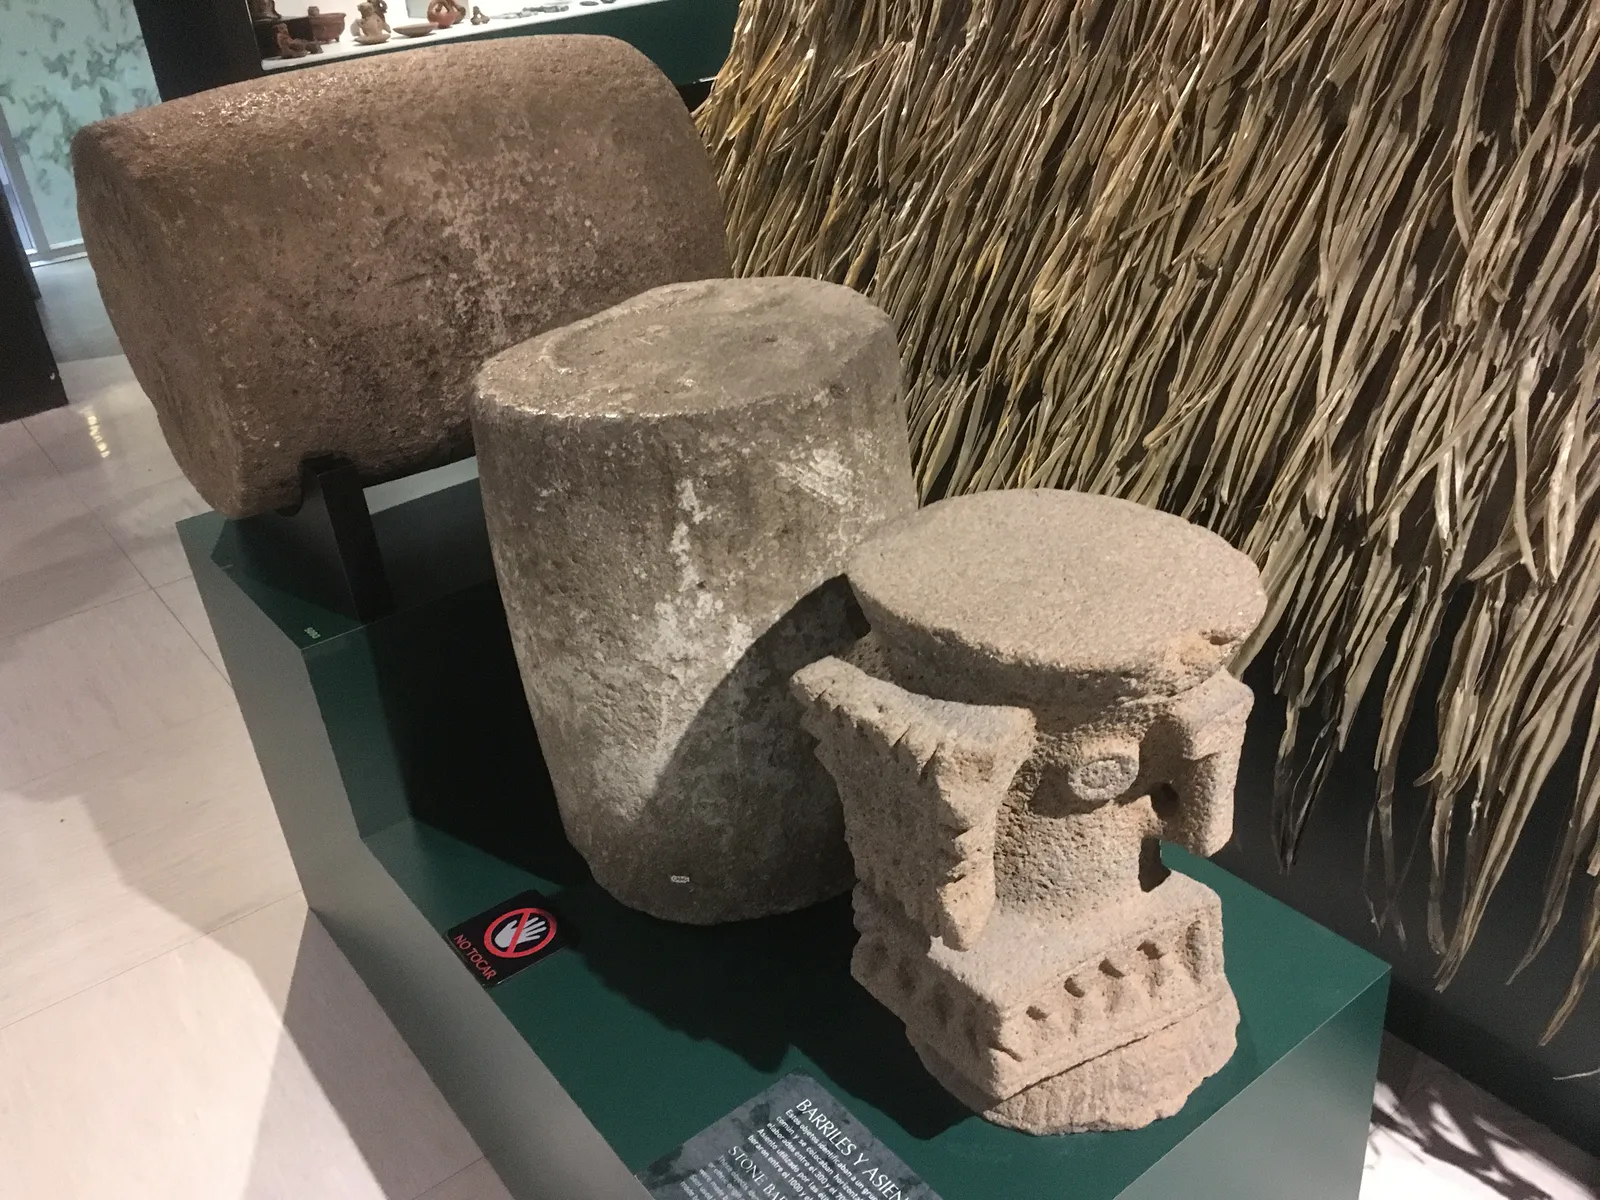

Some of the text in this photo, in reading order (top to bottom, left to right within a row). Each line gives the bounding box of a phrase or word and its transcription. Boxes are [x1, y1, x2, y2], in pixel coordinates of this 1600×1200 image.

[453, 934, 497, 980] NO TOCAR
[748, 1134, 770, 1158] boraron
[767, 1157, 783, 1172] entre
[788, 1177, 803, 1192] 1000
[757, 1128, 778, 1150] Asiento
[776, 1149, 800, 1173] utilizado
[796, 1172, 810, 1182] por
[808, 1181, 819, 1193] las
[767, 1123, 797, 1153] elaborados
[794, 1151, 810, 1167] entre
[814, 1171, 828, 1184] 300
[829, 1187, 838, 1195] el
[776, 1116, 795, 1135] común
[798, 1139, 807, 1147] se
[806, 1147, 834, 1175] colocaban
[785, 1109, 801, 1125] Estos
[800, 1124, 820, 1144] objetos
[817, 1141, 852, 1177] identificaban
[855, 1180, 864, 1189] un
[796, 1099, 857, 1156] BARRILES
[853, 1153, 869, 1166] Y
[728, 1146, 768, 1186] STONE
